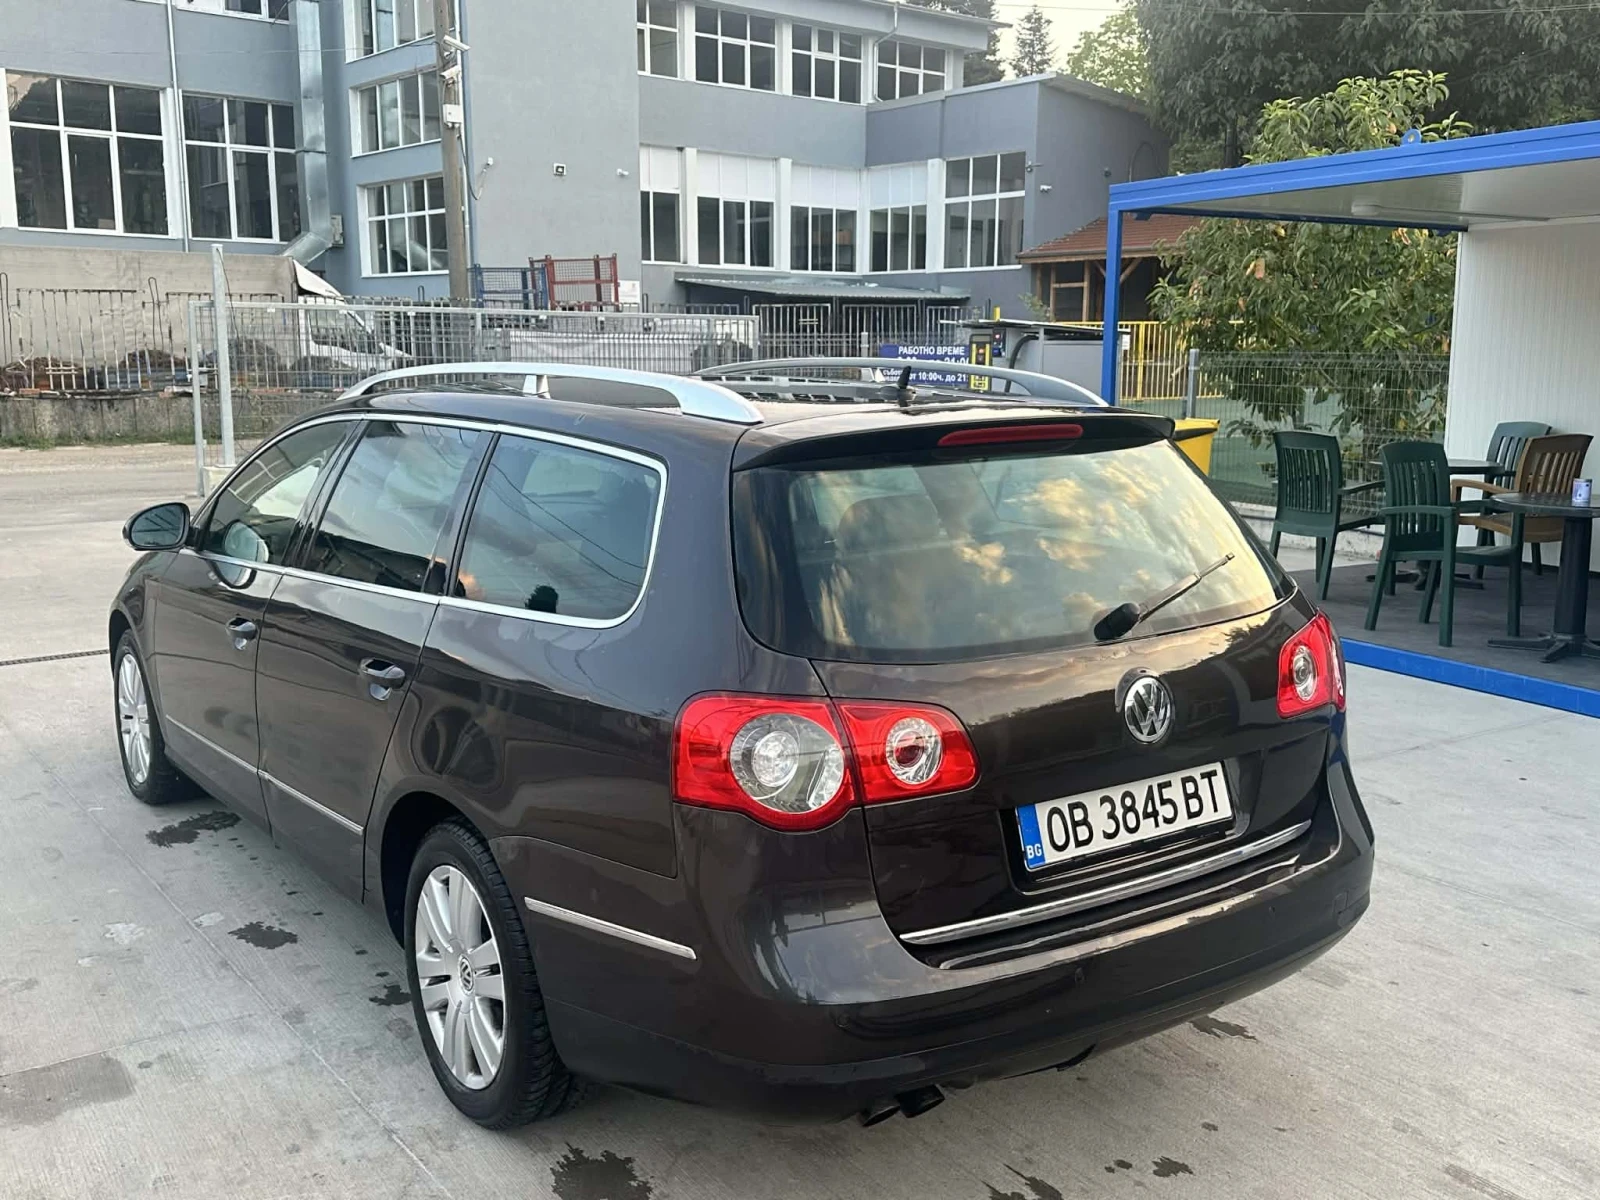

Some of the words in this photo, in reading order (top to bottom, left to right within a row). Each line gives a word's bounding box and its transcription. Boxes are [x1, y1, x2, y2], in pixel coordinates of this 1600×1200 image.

[898, 346, 935, 355] РАБОТНО
[937, 346, 965, 355] ВРЕМЕ
[1046, 801, 1094, 852] OB
[1100, 780, 1178, 840] 3845
[1181, 769, 1218, 820] BT
[1026, 844, 1042, 859] BG
